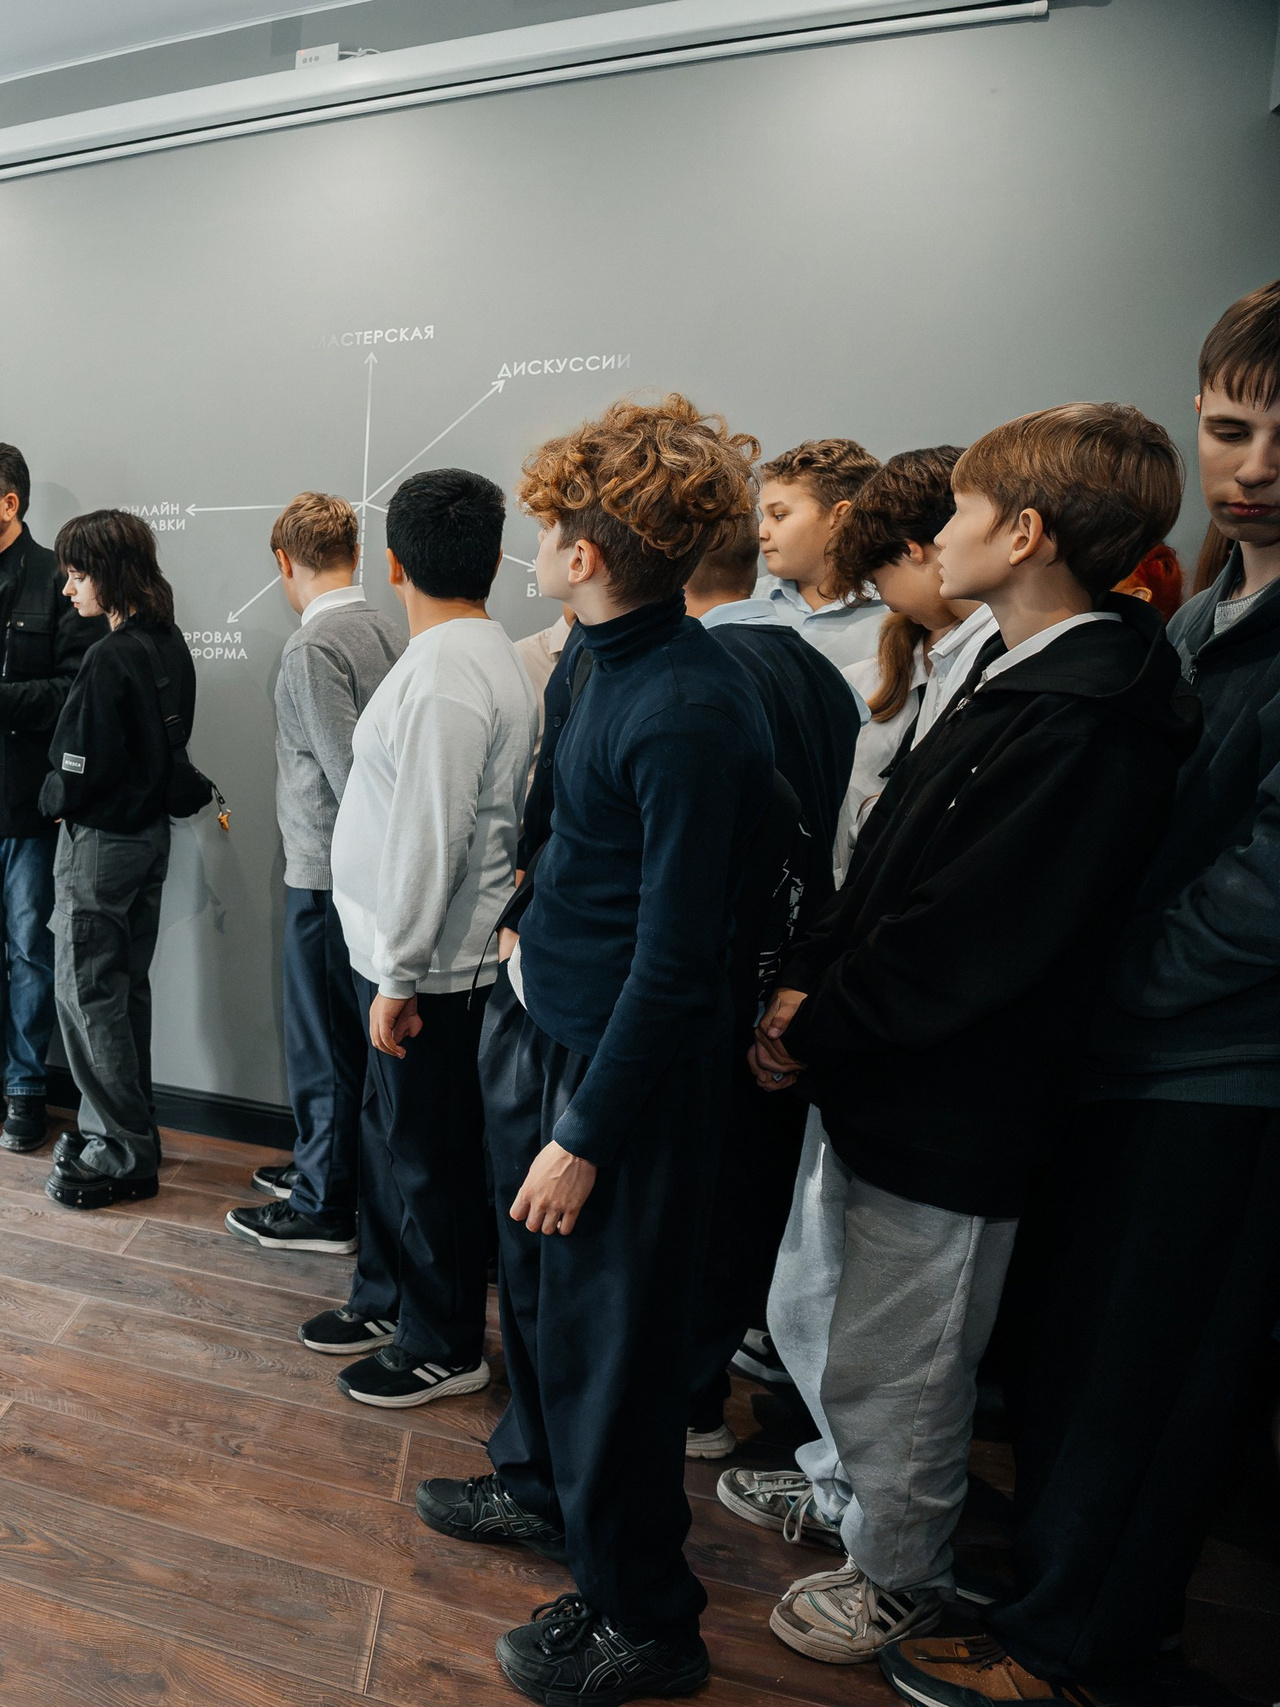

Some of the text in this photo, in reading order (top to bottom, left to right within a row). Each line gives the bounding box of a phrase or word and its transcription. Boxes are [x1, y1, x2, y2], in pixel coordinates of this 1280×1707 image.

[497, 353, 631, 379] ДИСКУССИИ
[120, 501, 179, 517] ОНЛАЙН
[146, 519, 186, 531] АВКИ
[189, 647, 248, 660] ФОРМА
